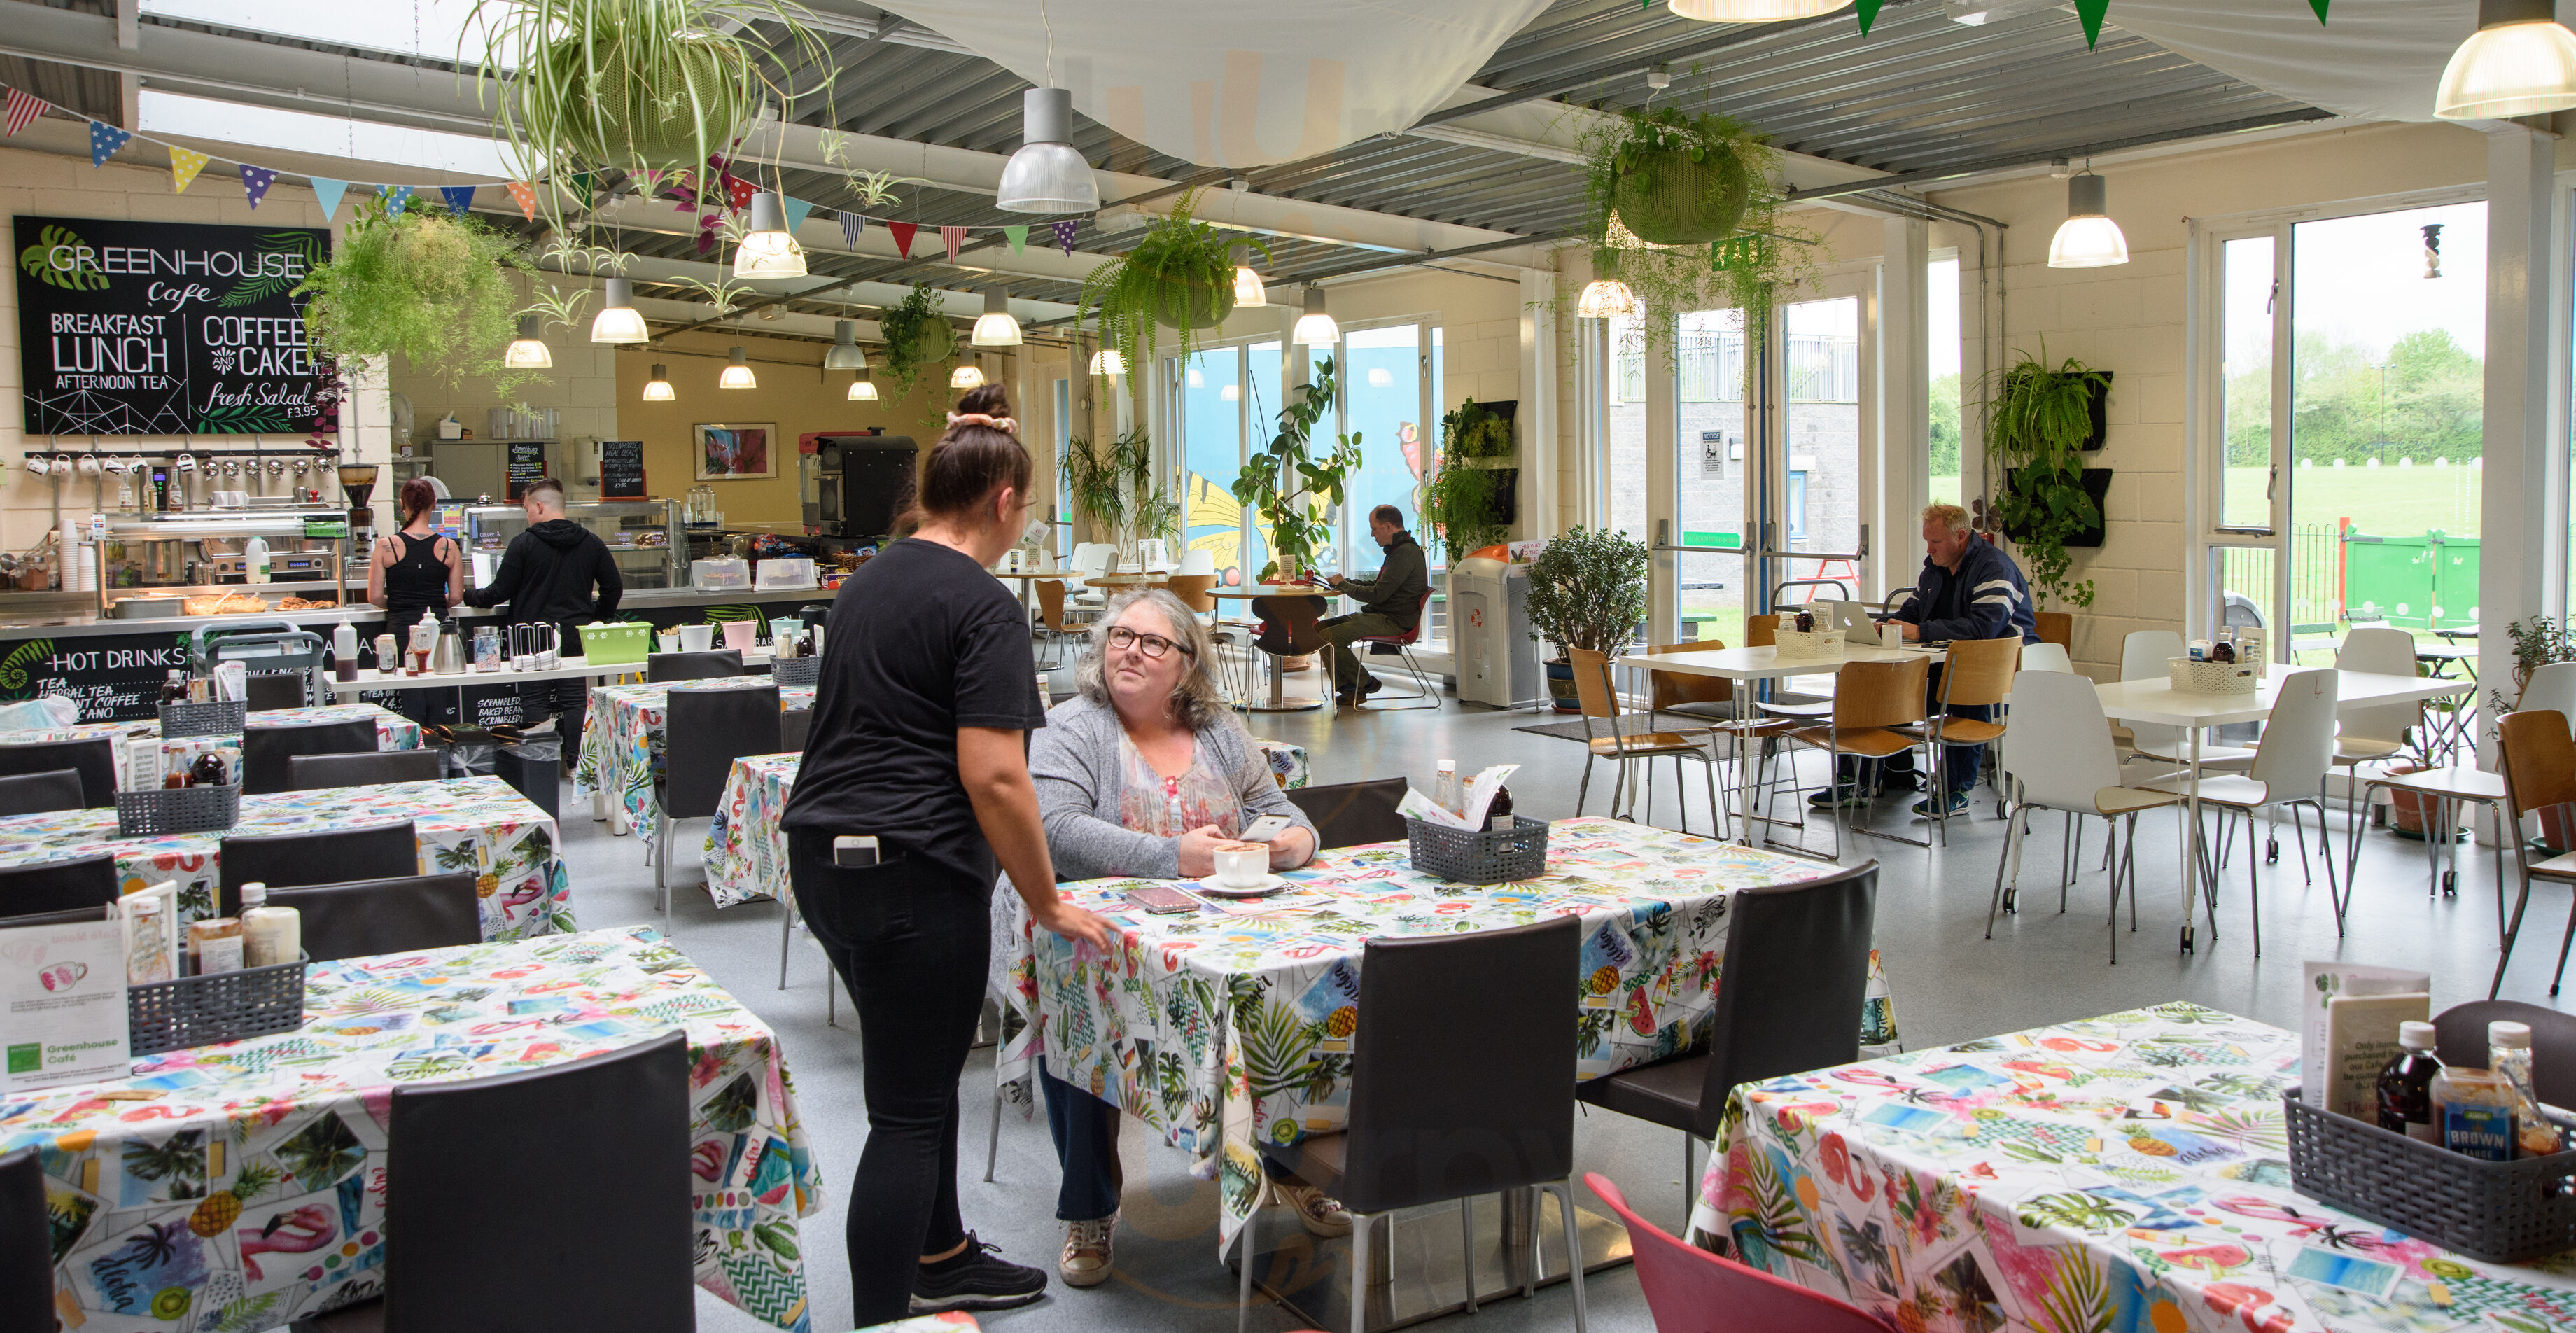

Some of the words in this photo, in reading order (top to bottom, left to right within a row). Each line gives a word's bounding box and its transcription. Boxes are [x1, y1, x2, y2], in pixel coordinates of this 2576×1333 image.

[49, 246, 305, 279] GREENHOUSE
[51, 313, 166, 335] BREAKFAST
[204, 316, 308, 347] COFFEE
[52, 336, 168, 373] LUNCH
[212, 356, 235, 366] AND
[239, 347, 310, 377] CAKE
[56, 375, 136, 389] AFTERNOON
[143, 375, 169, 390] TEA
[200, 384, 253, 414] fresh
[255, 382, 312, 407] Salad
[287, 405, 319, 419] £3.95
[52, 652, 101, 671] HOT
[106, 647, 187, 669] DRINKS
[37, 677, 68, 690] TEA
[89, 685, 114, 697] TEA
[94, 695, 141, 708] COFFEE
[477, 696, 521, 708] SCRAMBLED
[478, 707, 503, 717] BAKED
[504, 706, 523, 715] BEAN
[47, 1038, 118, 1054] Greenhouse
[2355, 1041, 2374, 1052] Only
[48, 1054, 76, 1064] Café
[2451, 1131, 2505, 1147] BROWN
